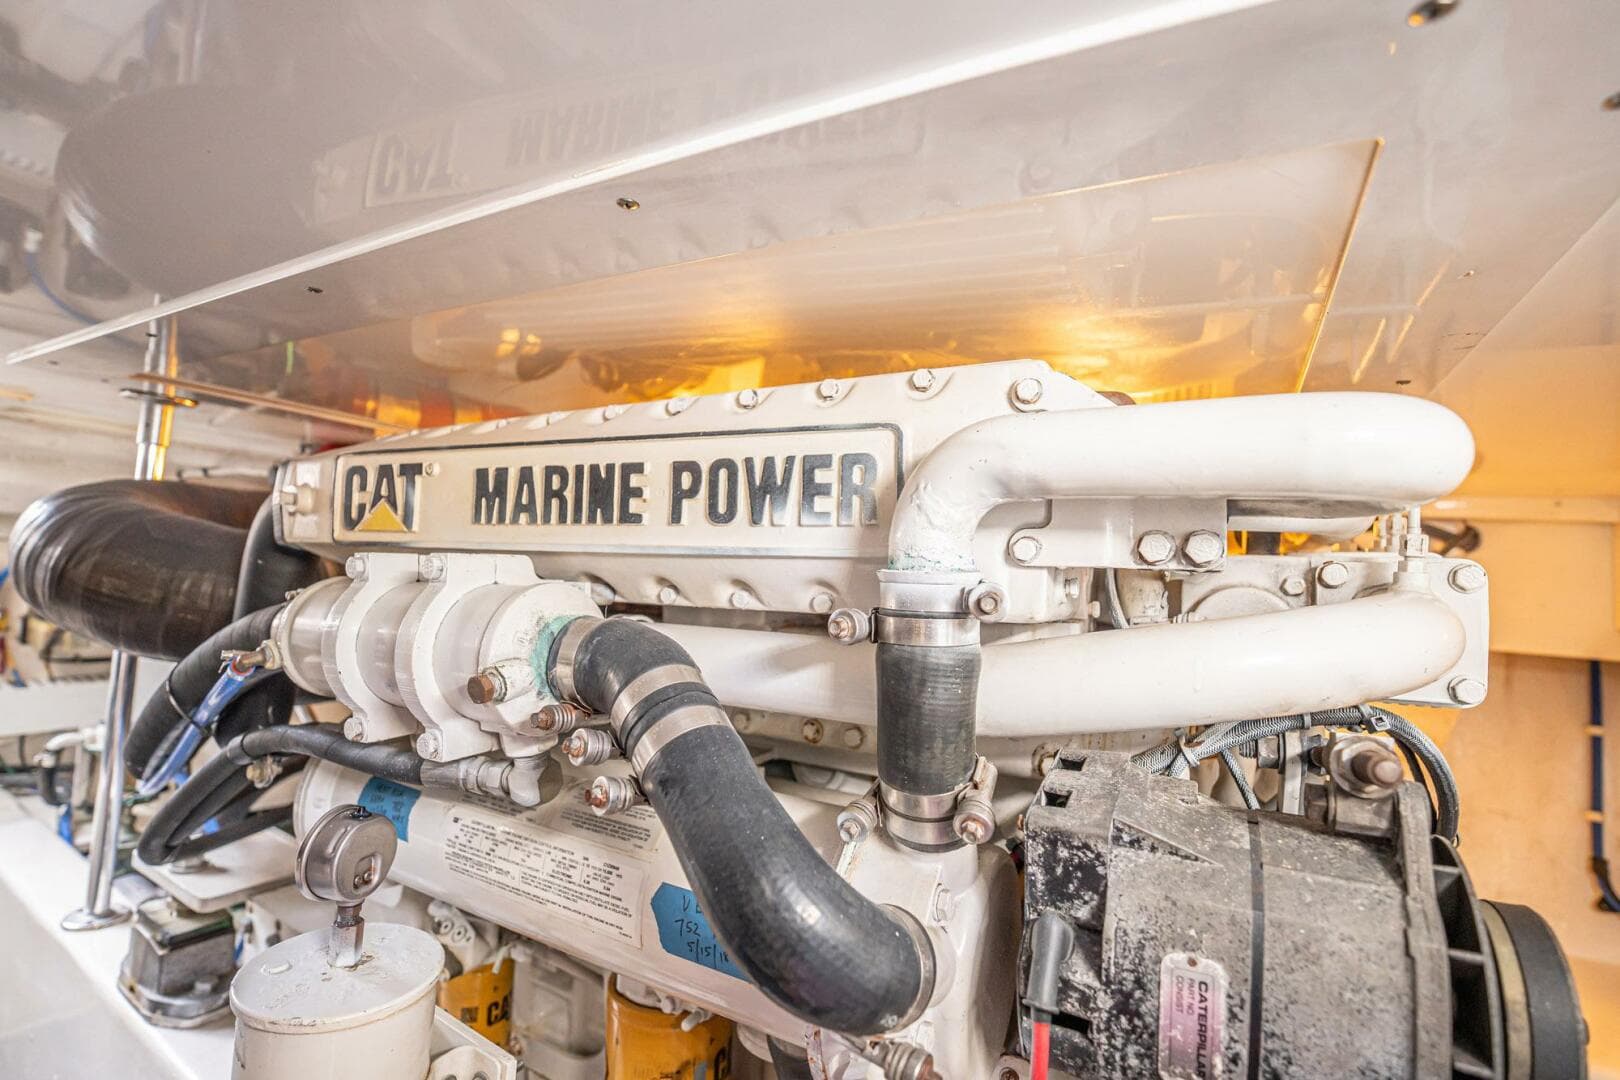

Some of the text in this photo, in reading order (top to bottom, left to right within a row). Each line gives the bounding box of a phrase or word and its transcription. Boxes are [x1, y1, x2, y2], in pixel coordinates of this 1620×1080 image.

[344, 453, 878, 531] CAT MARINE POWER
[674, 919, 701, 937] 752
[487, 994, 512, 1026] CA
